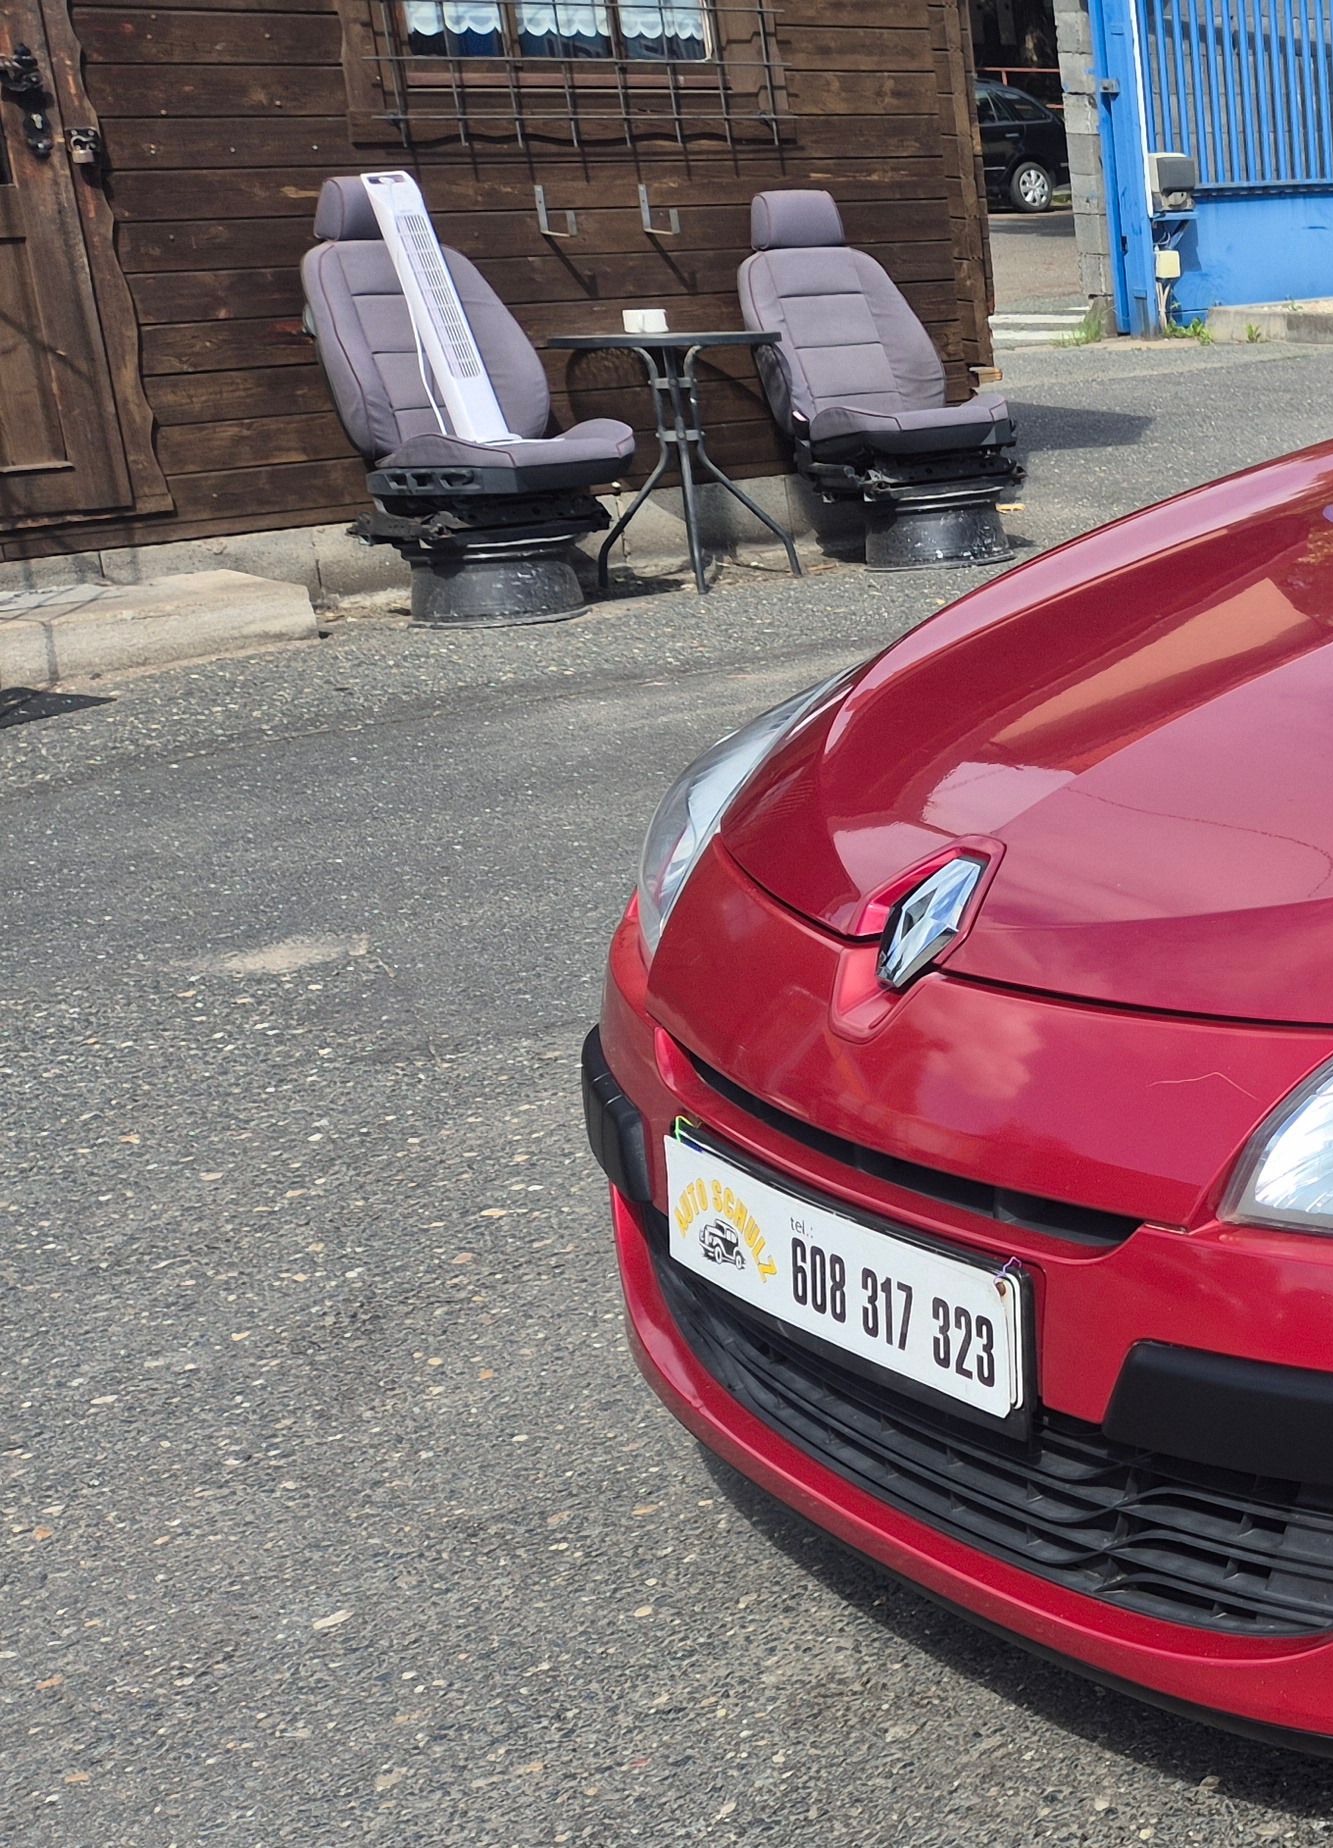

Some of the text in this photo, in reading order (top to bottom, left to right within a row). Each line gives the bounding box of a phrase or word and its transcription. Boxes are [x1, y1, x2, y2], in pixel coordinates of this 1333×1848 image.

[674, 1178, 778, 1284] AUTO SCHULZ
[791, 1236, 996, 1388] 608 317 323
